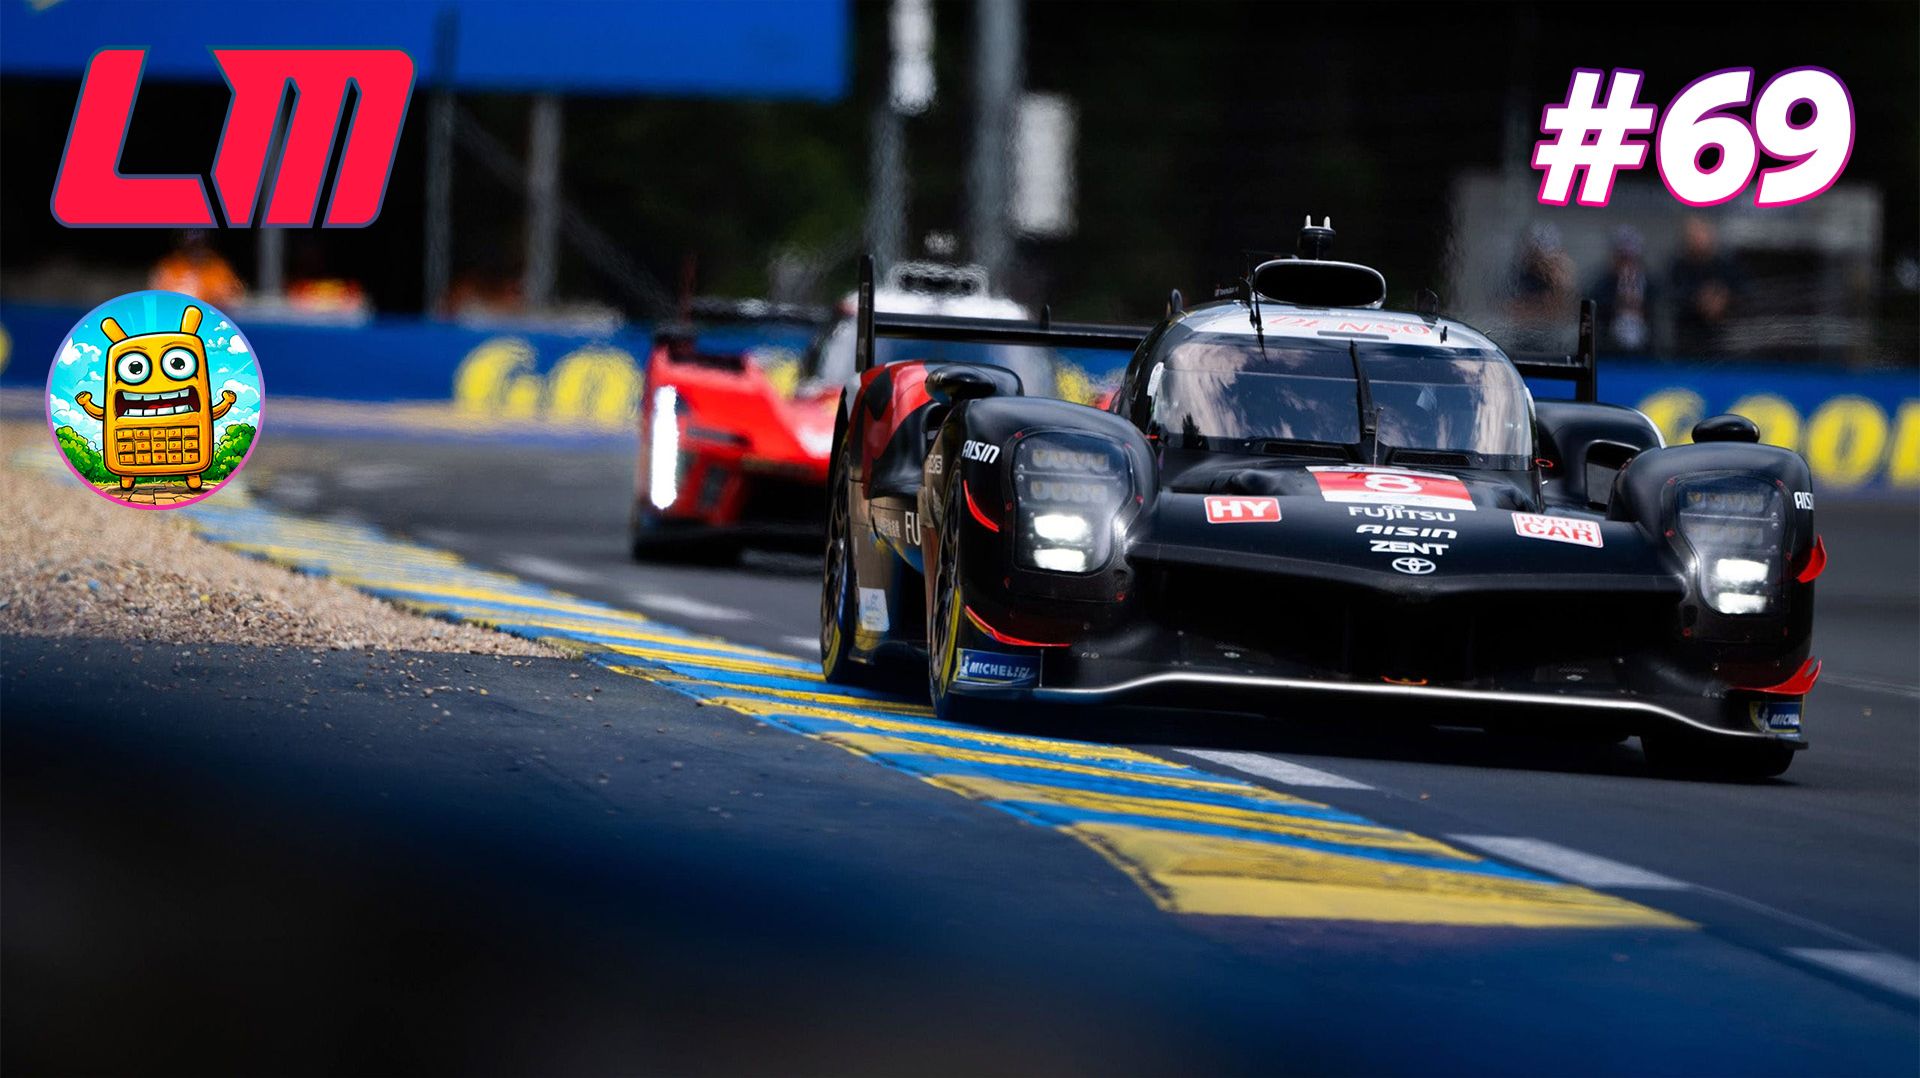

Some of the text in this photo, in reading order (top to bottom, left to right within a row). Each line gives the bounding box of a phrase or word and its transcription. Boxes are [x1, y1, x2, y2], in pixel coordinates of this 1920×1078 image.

[962, 440, 1000, 464] AISIN
[1364, 473, 1422, 493] 8
[1210, 500, 1272, 518] HY
[1349, 501, 1456, 522] FUJITSU
[1356, 524, 1458, 539] AISIN
[1523, 522, 1594, 543] CAR
[1369, 540, 1450, 556] ZENT
